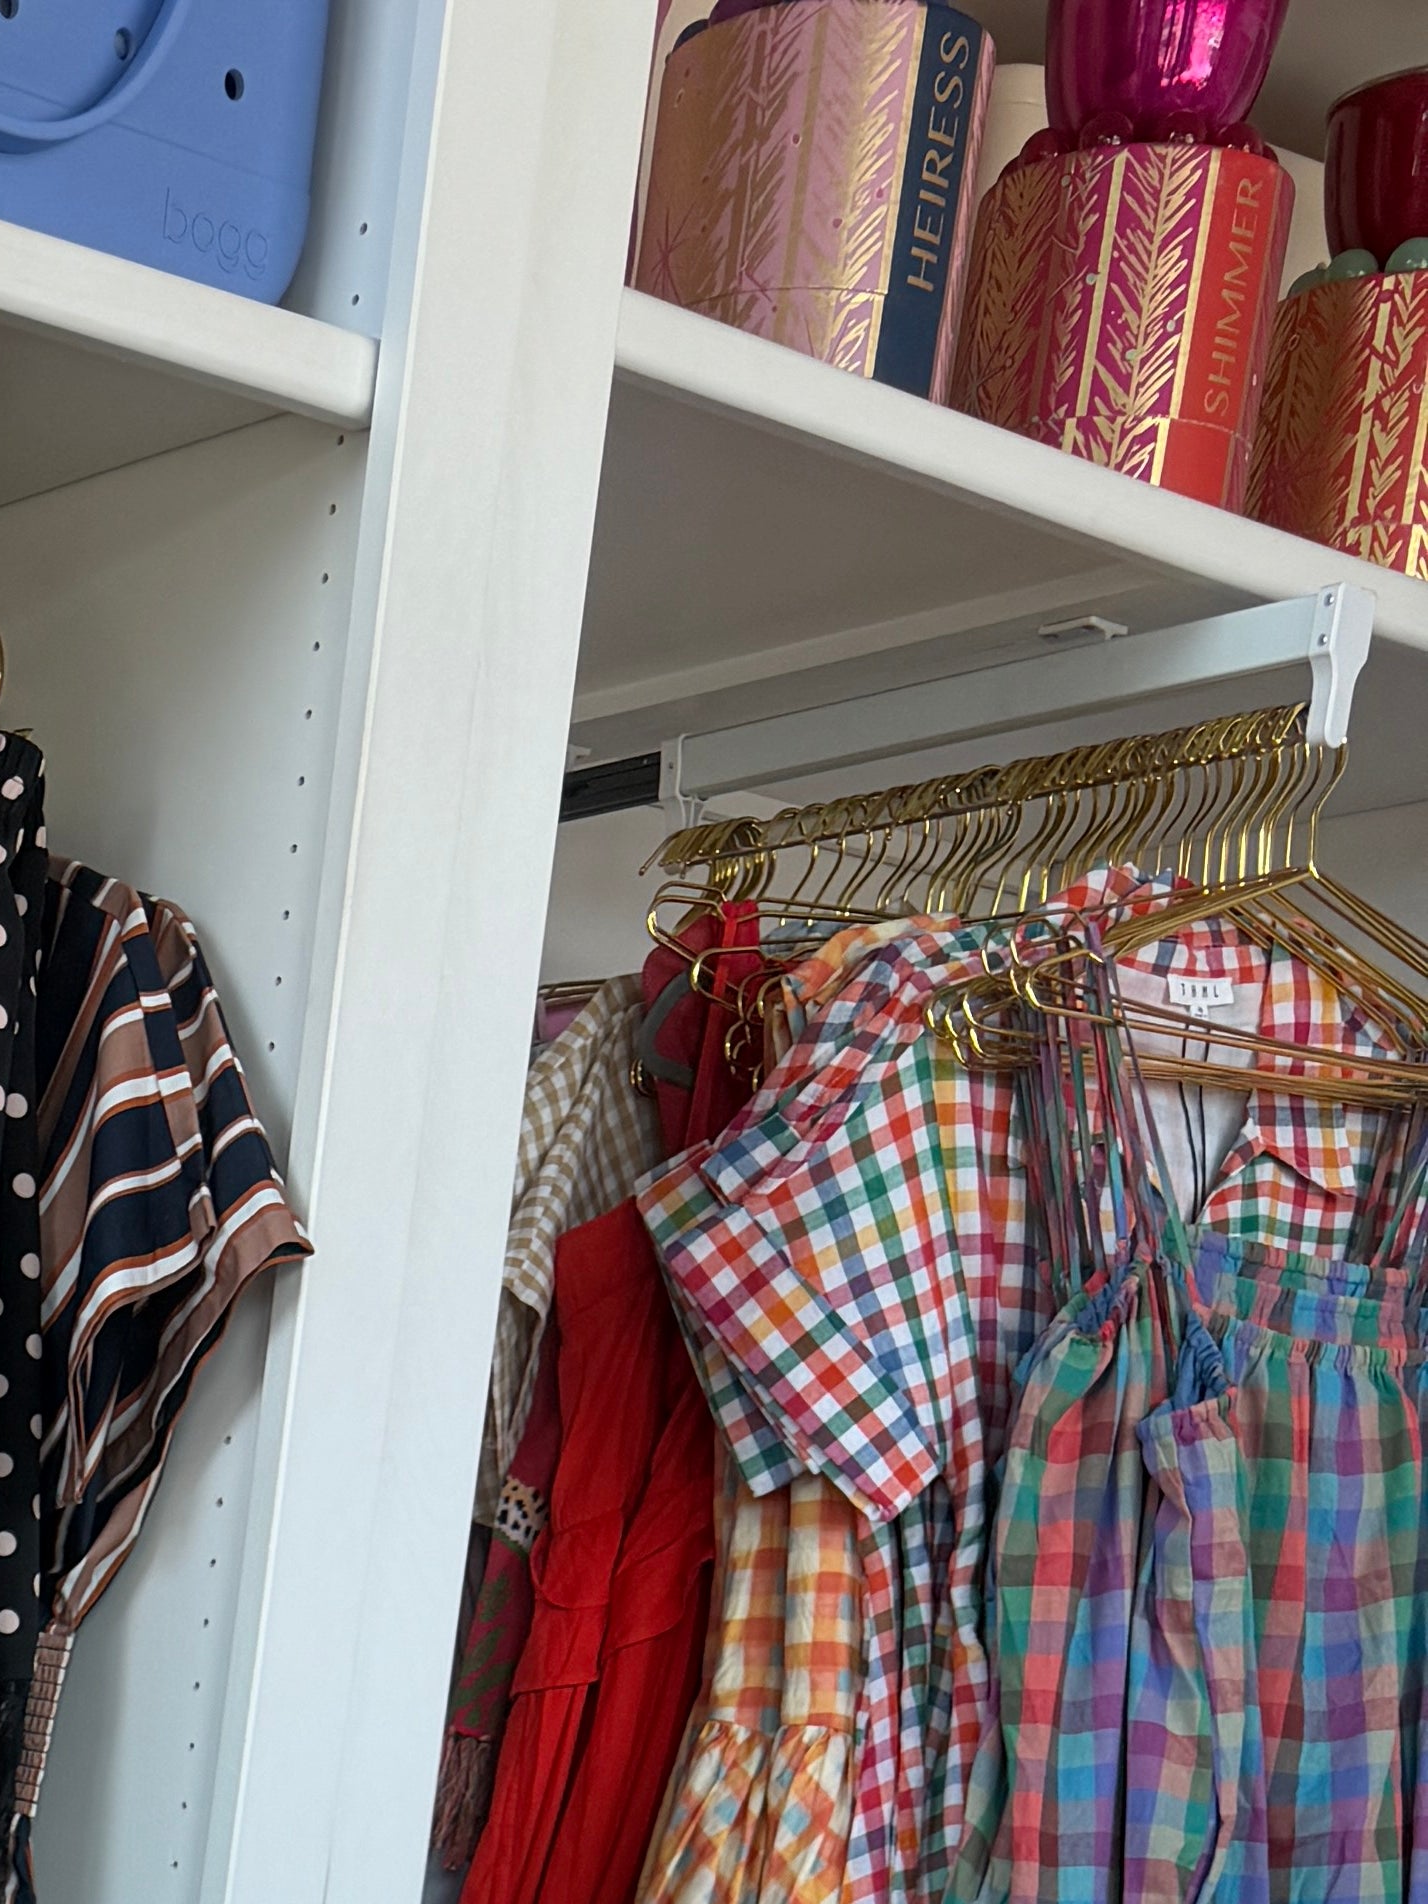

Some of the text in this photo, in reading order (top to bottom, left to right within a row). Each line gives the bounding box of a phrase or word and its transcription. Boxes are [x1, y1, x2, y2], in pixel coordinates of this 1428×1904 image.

[162, 186, 268, 281] bogg
[906, 30, 970, 293] HEIRESS
[1203, 177, 1263, 417] SHIMMER
